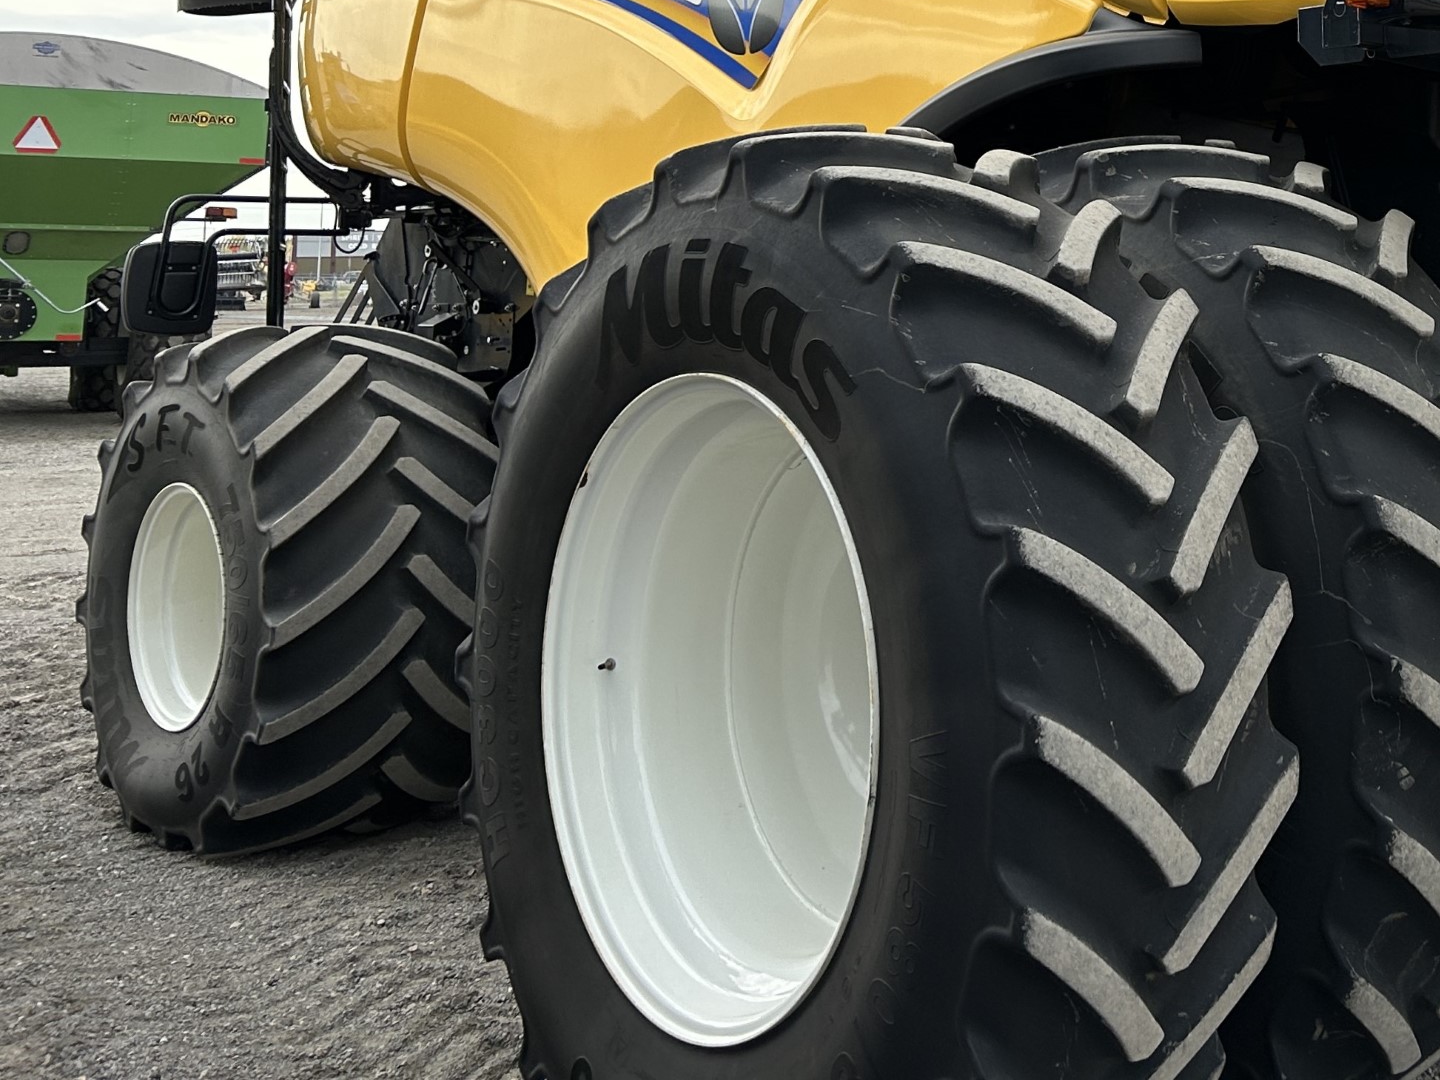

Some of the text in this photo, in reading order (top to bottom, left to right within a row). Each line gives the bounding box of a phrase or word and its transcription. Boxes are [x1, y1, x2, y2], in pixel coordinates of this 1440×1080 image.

[168, 112, 237, 125] MANDAKO
[599, 237, 859, 442] Mitas
[125, 402, 206, 474] SFT
